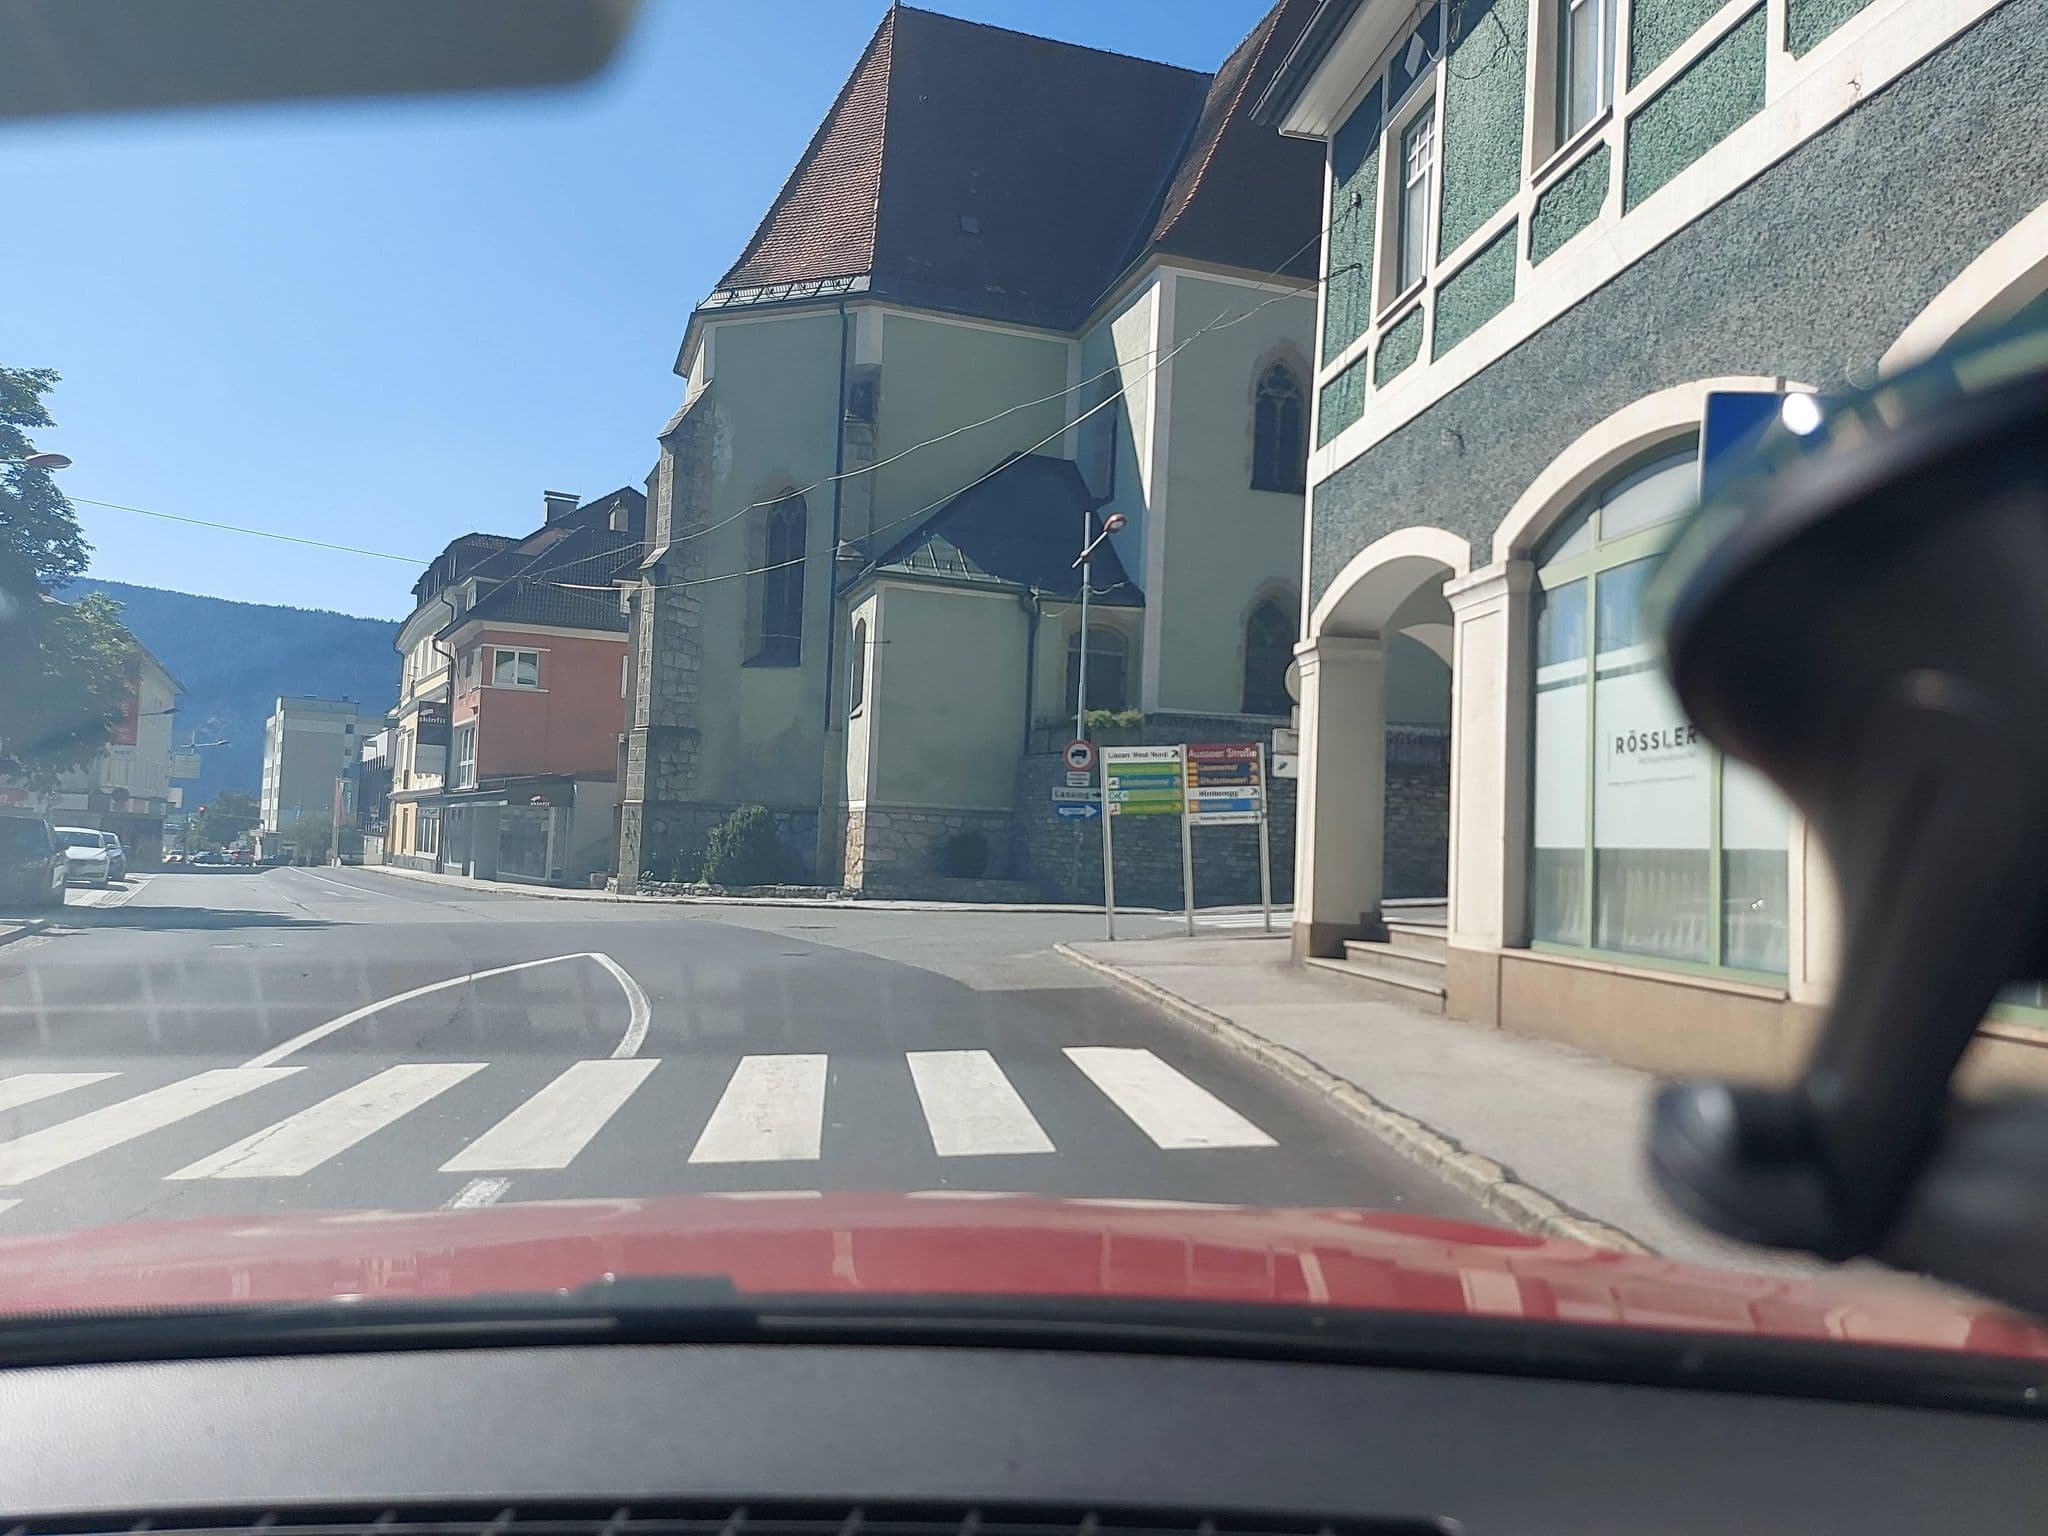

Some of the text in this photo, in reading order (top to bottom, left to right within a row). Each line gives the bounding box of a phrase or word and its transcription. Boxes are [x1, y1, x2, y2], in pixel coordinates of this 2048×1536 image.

[419, 716, 446, 724] skinfit
[1615, 725, 1697, 755] RÖSSLER
[1054, 791, 1090, 800] Lassing
